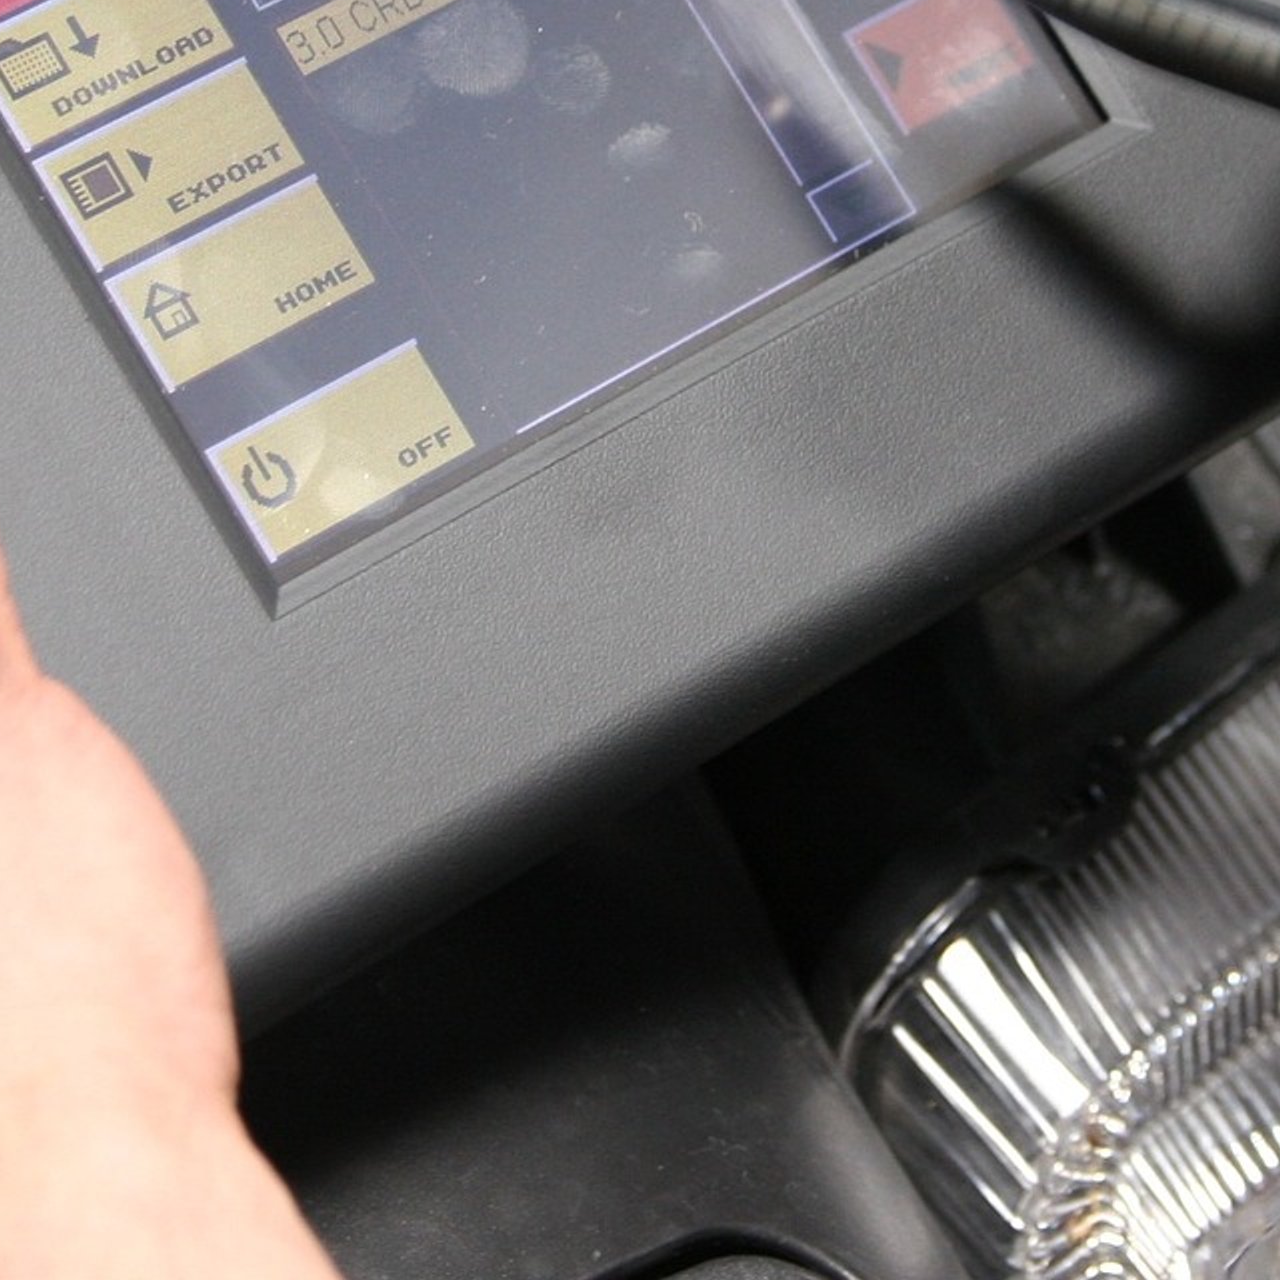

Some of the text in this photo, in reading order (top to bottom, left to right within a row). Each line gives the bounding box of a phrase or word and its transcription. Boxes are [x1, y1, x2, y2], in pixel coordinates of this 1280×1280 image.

[282, 12, 349, 67] 3.0
[47, 24, 218, 117] DOWNLOAD
[163, 140, 289, 215] EXPORT
[271, 258, 360, 315] HOME
[393, 424, 458, 470] OFF
